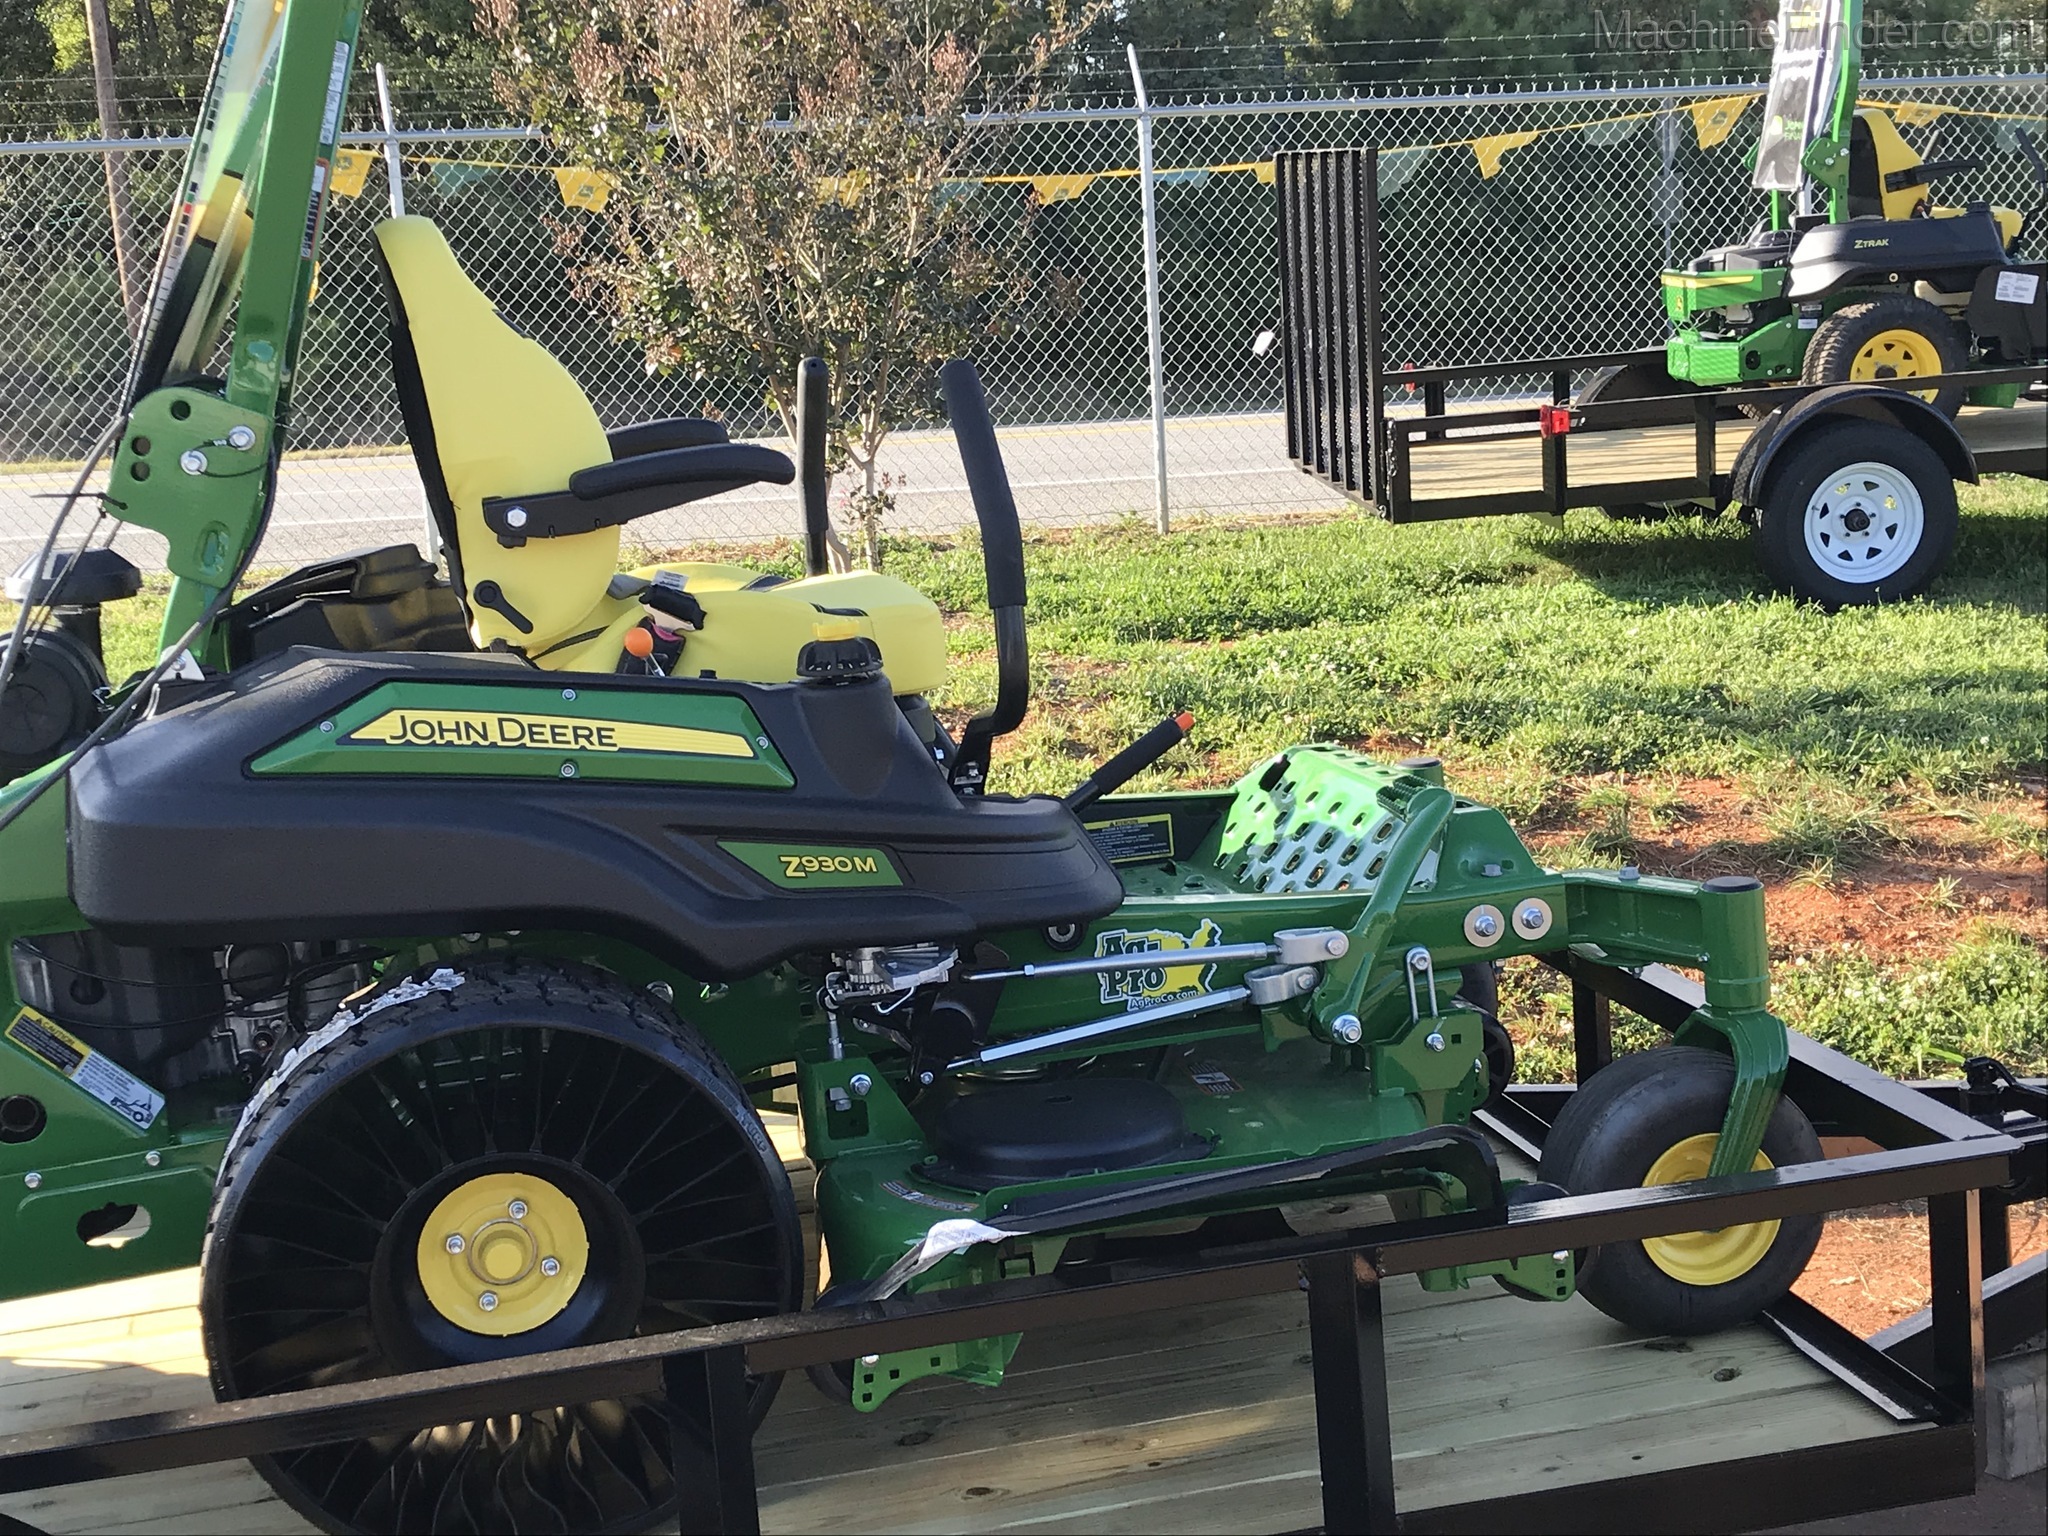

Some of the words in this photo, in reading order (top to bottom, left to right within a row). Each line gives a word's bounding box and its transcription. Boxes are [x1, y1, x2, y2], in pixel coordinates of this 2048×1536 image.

[1854, 238, 1890, 250] ZTRAK
[389, 715, 489, 742] JOHN
[497, 717, 618, 748] DEERE
[779, 855, 878, 878] Z930M
[1104, 967, 1166, 1000] Pro
[1131, 989, 1197, 1009] AgProCo.com
[42, 1021, 75, 1046] CAUTION
